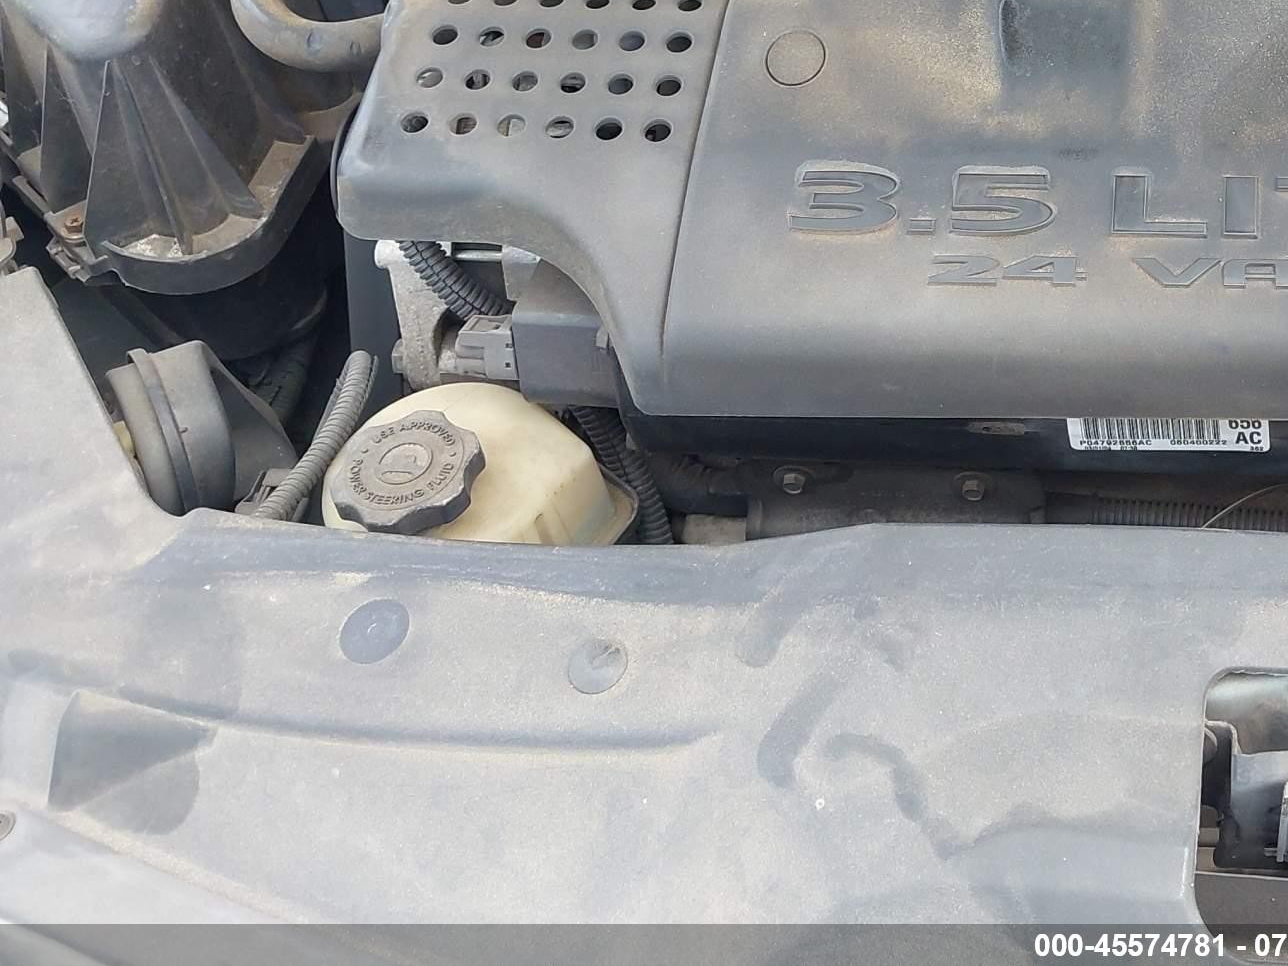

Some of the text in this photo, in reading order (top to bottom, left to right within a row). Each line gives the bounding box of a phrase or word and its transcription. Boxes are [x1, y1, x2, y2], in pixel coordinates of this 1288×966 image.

[787, 168, 1057, 234] 3.5
[927, 254, 1088, 286] 24
[372, 421, 456, 446] USE APPROVED
[1235, 431, 1262, 445] AC
[349, 458, 454, 506] POWER STEERING FLUID
